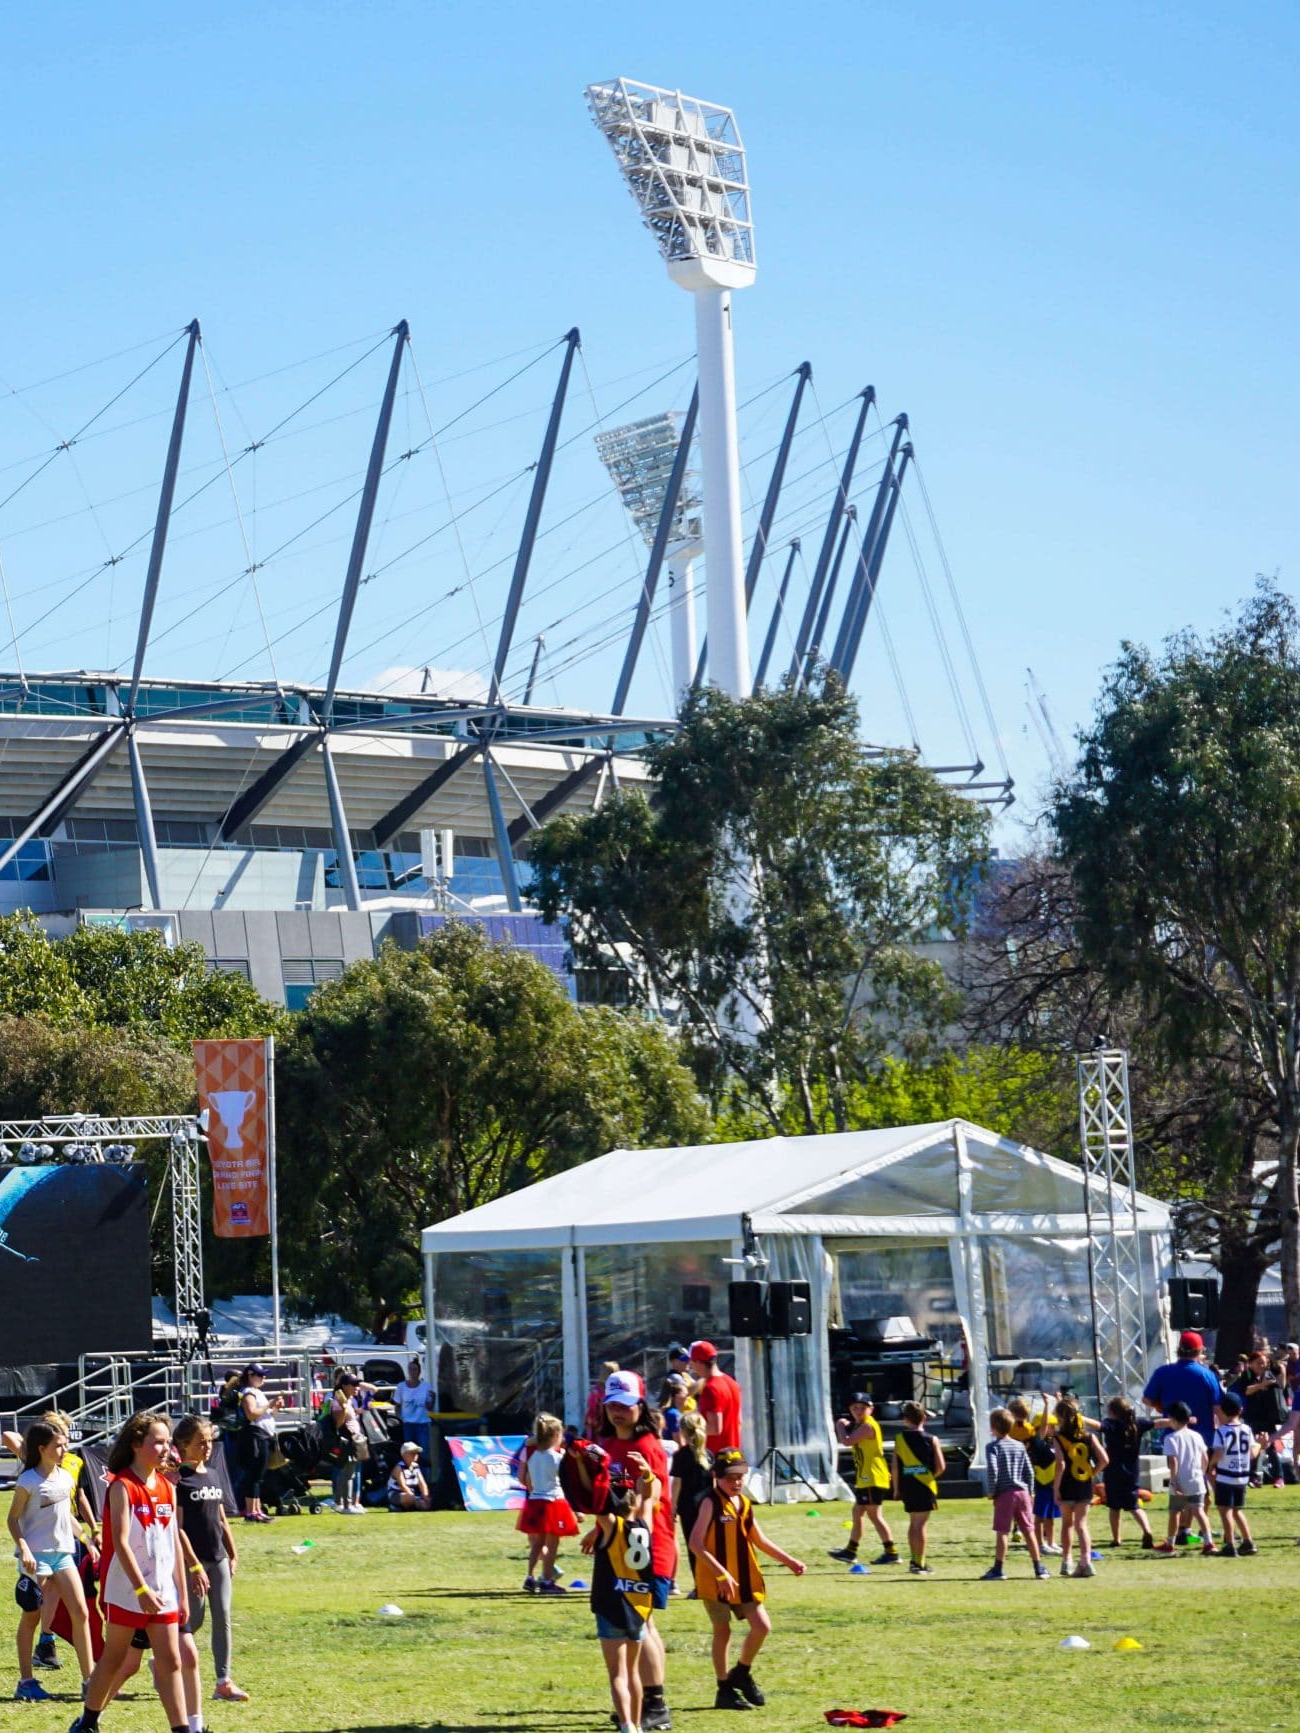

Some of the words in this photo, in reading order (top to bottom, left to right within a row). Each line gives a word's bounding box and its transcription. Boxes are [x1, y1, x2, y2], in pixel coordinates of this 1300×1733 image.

[1225, 1431, 1249, 1455] 26
[1068, 1442, 1093, 1482] 8
[190, 1485, 222, 1501] adida
[624, 1527, 651, 1570] 8
[614, 1577, 650, 1594] AFG
